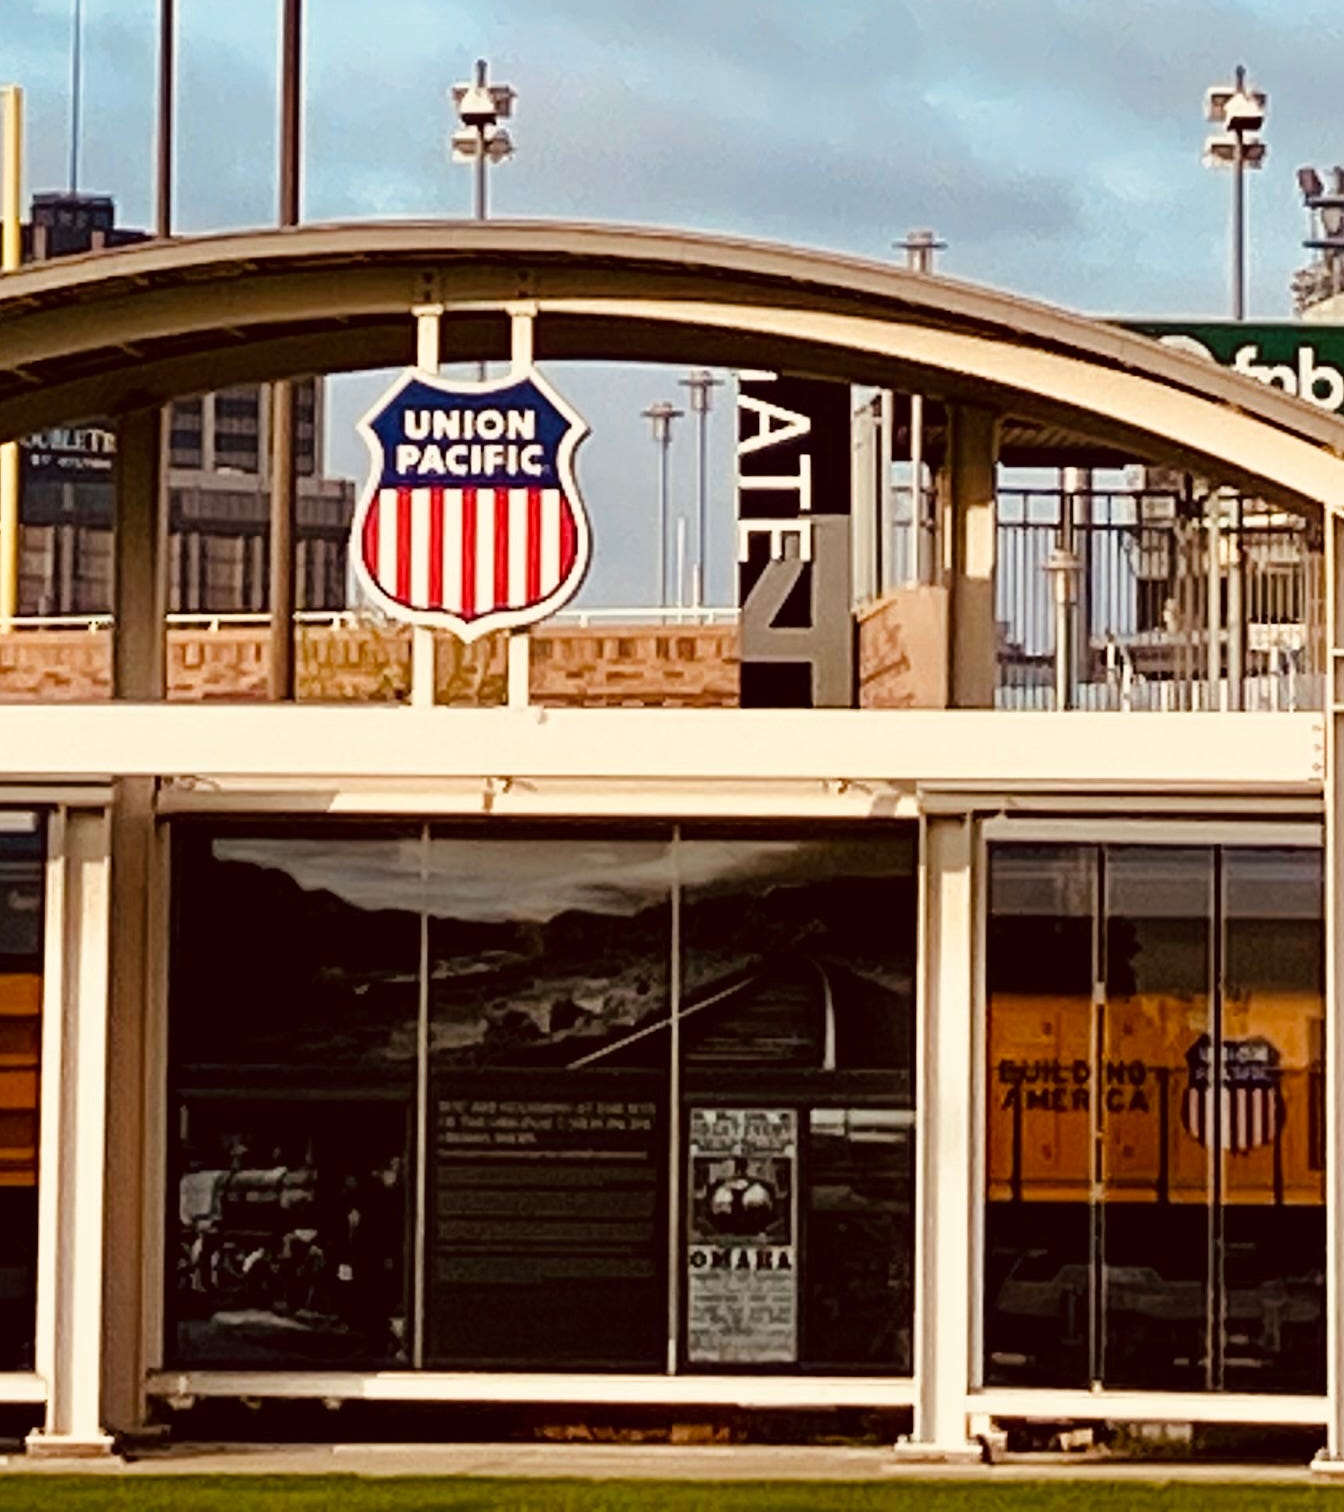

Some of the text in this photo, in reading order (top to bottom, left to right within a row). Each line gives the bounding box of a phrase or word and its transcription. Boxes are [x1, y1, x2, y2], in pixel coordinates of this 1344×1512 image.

[404, 409, 536, 440] UNION
[396, 444, 544, 477] PACIFIC
[998, 1058, 1148, 1085] BUILDNG
[1001, 1089, 1149, 1113] AMERCA
[690, 1247, 792, 1272] OMAHA
